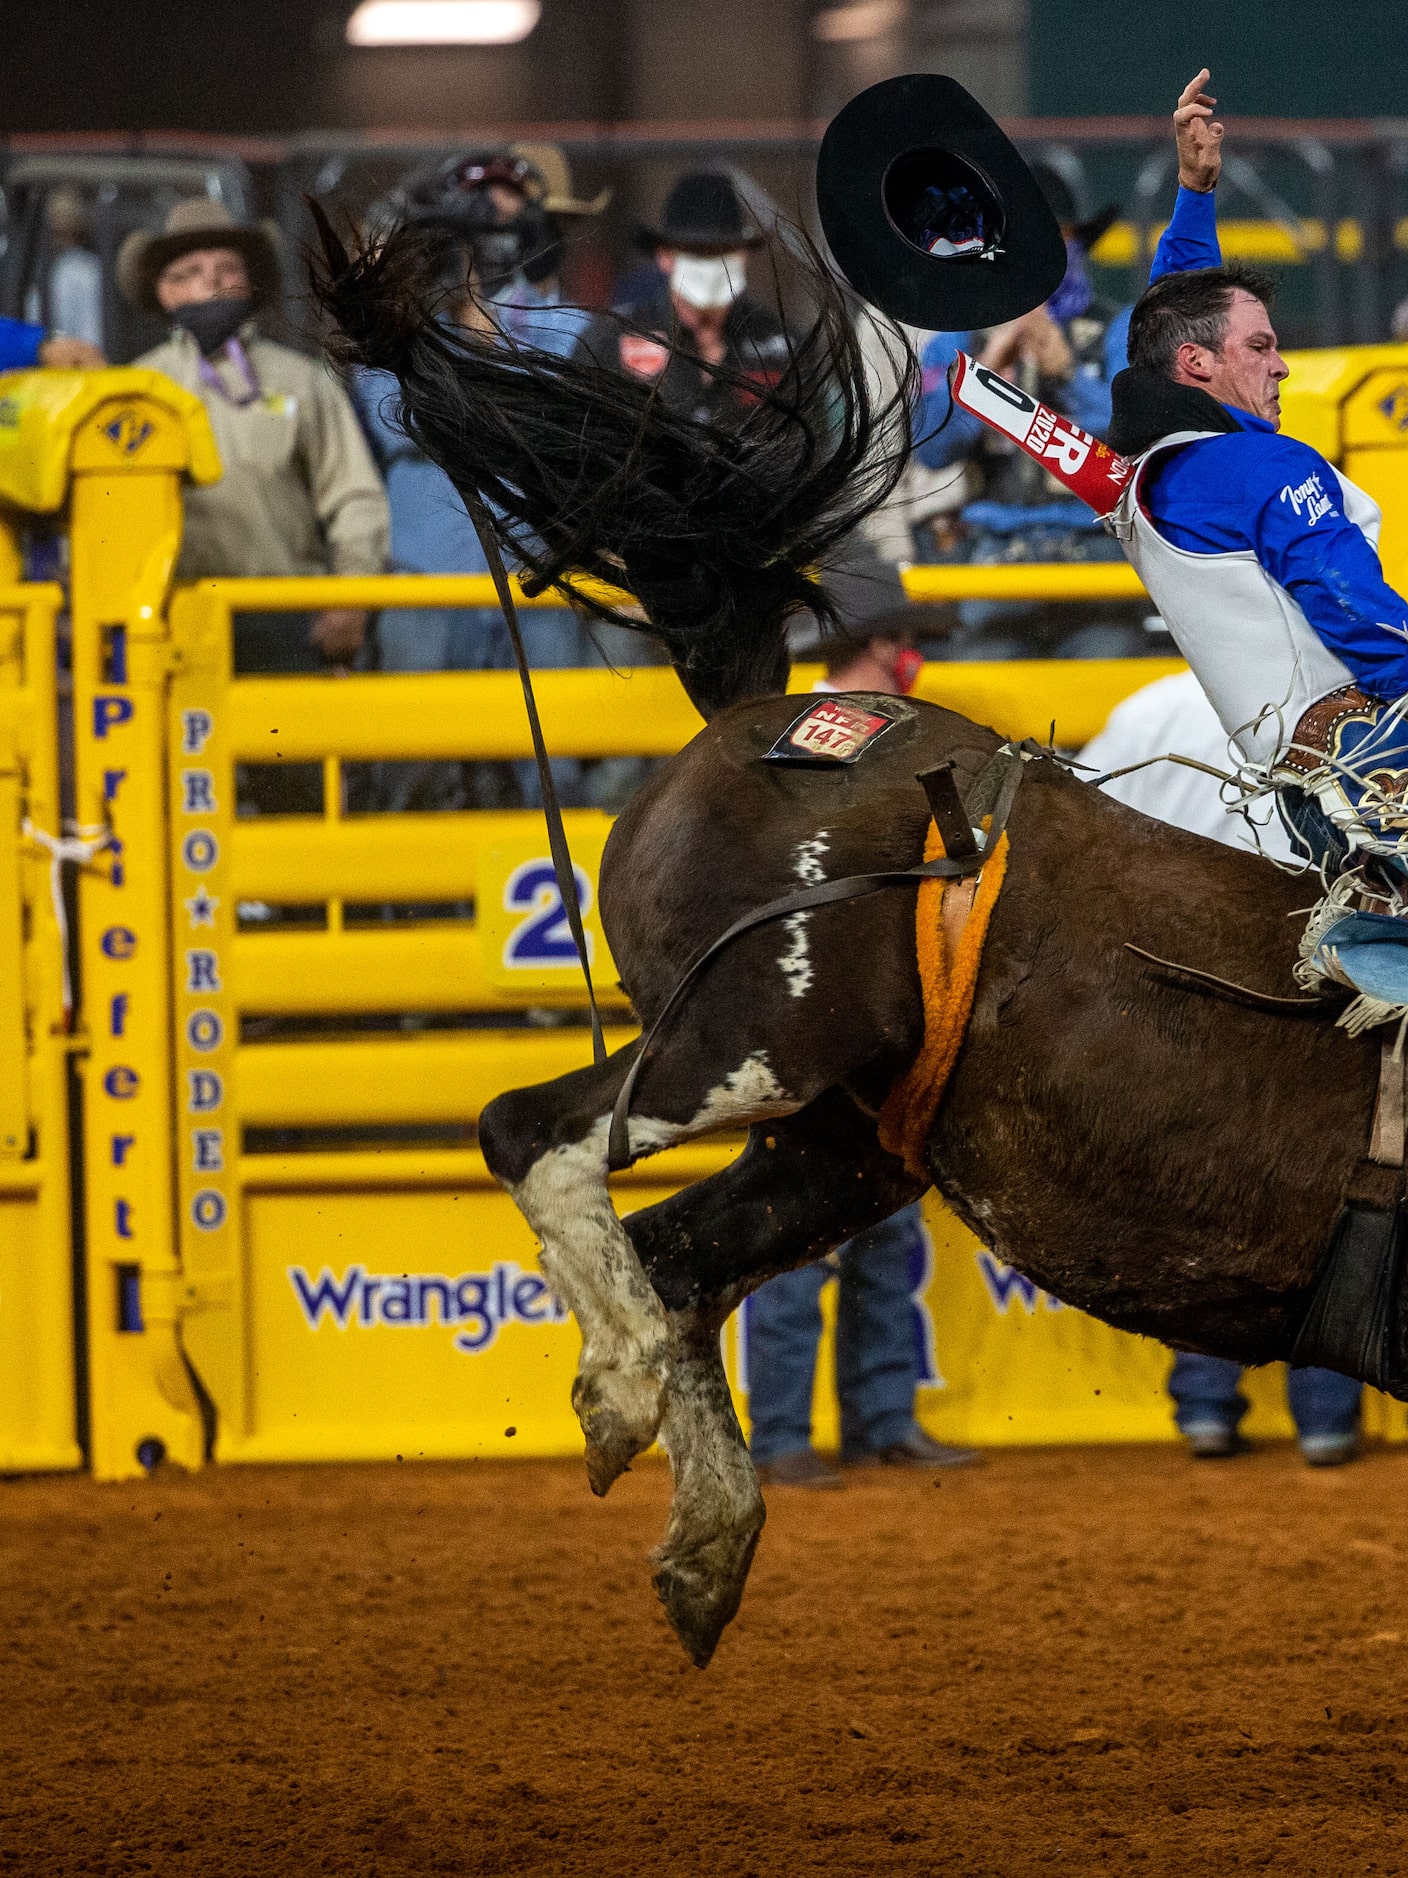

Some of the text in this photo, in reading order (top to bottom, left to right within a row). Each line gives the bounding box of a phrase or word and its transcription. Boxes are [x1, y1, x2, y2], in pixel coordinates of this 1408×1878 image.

[1026, 407, 1057, 454] 2020
[803, 724, 854, 749] 147
[503, 857, 595, 970] 2
[287, 1259, 572, 1355] Wrangle
